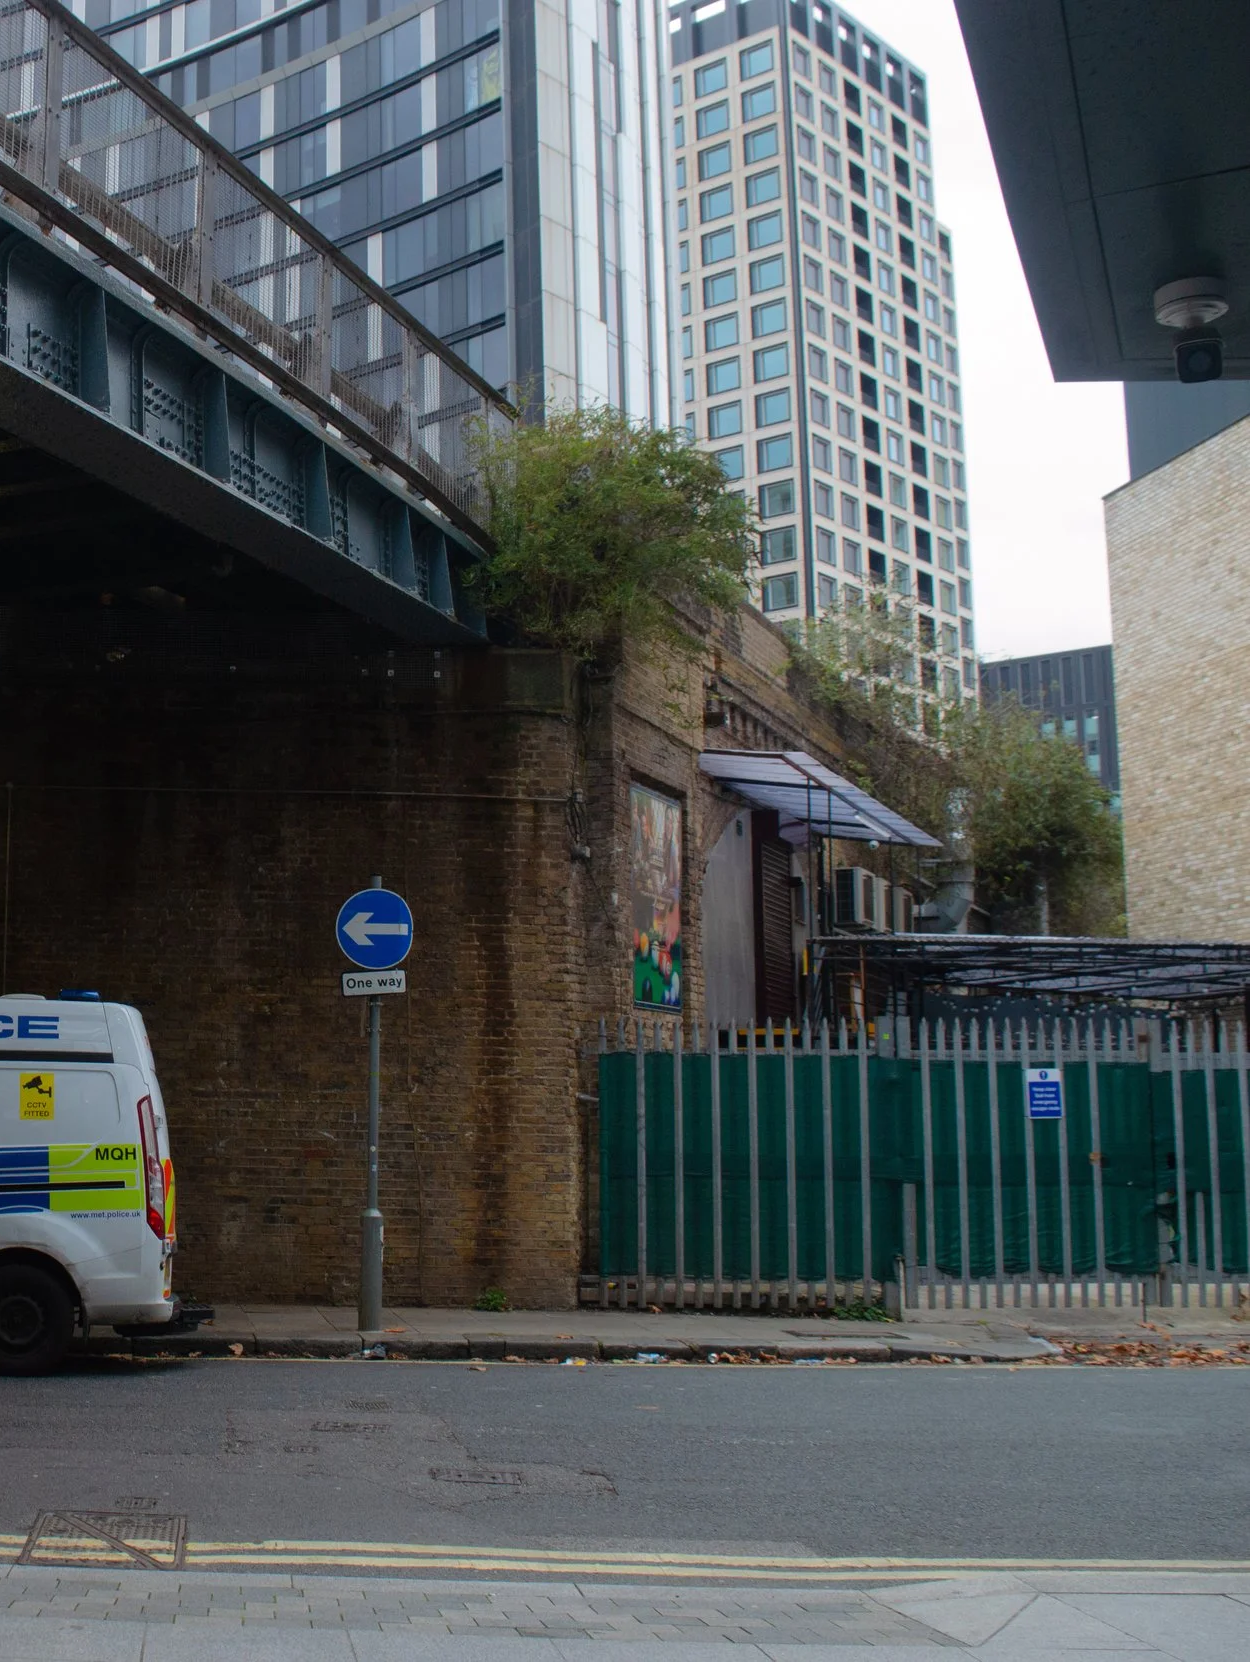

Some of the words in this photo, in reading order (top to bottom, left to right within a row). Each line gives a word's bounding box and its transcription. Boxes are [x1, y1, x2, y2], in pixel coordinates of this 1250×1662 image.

[346, 978, 373, 989] One
[377, 977, 403, 988] way
[95, 1147, 137, 1161] MQH
[70, 1210, 141, 1220] www.met.police.uk
